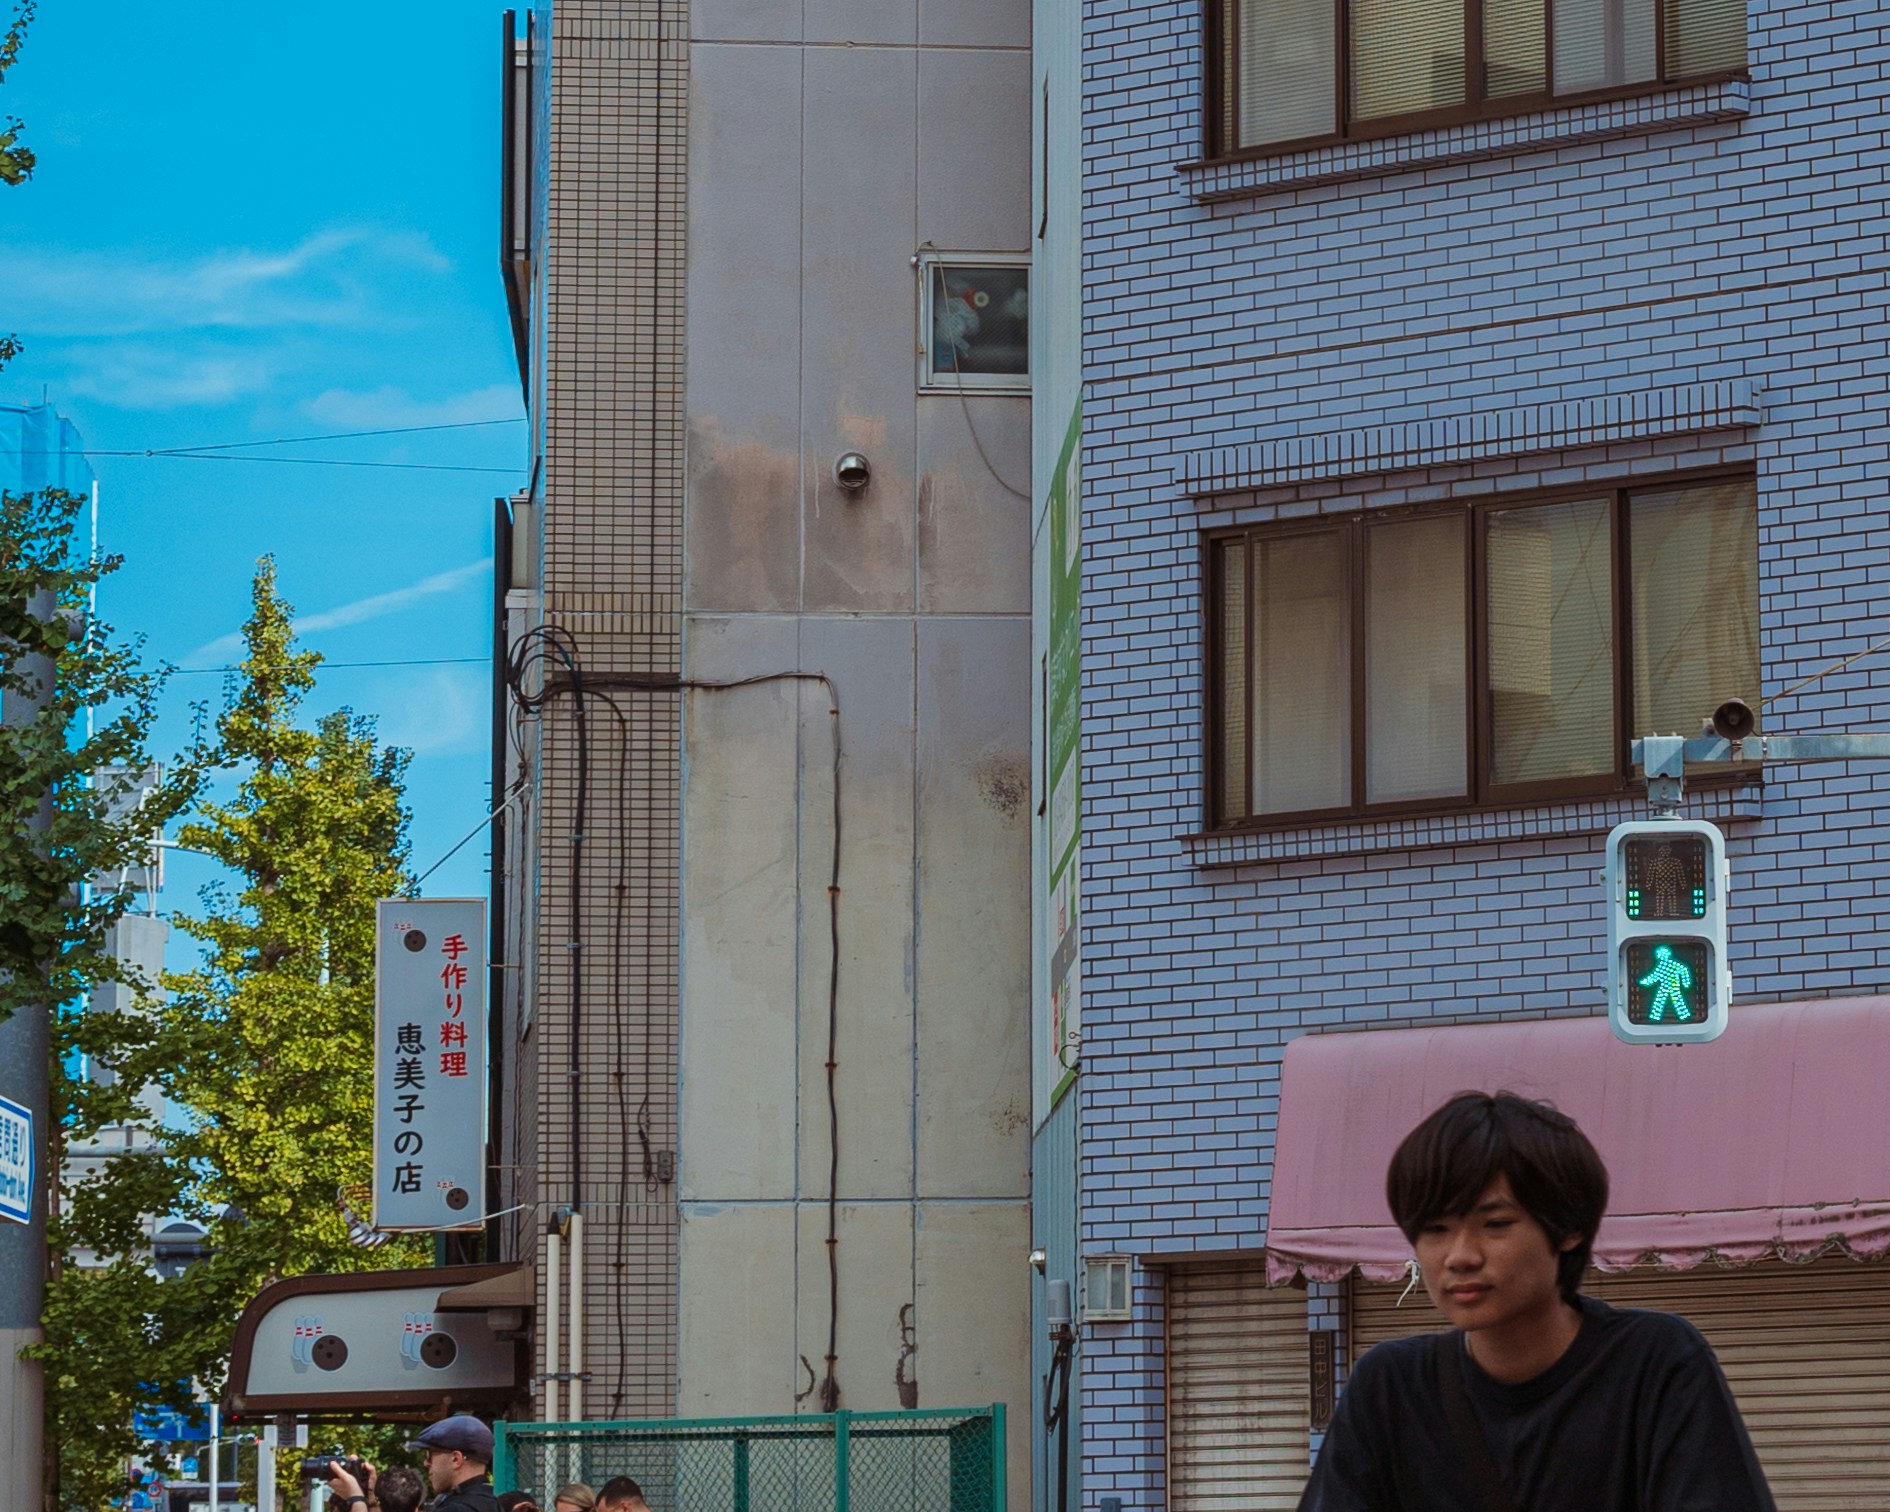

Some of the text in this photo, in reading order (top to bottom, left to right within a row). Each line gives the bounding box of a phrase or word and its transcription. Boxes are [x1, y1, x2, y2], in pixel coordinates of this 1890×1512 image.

[439, 934, 468, 1077] 手作り料理
[392, 1022, 426, 1194] 恵美子の店
